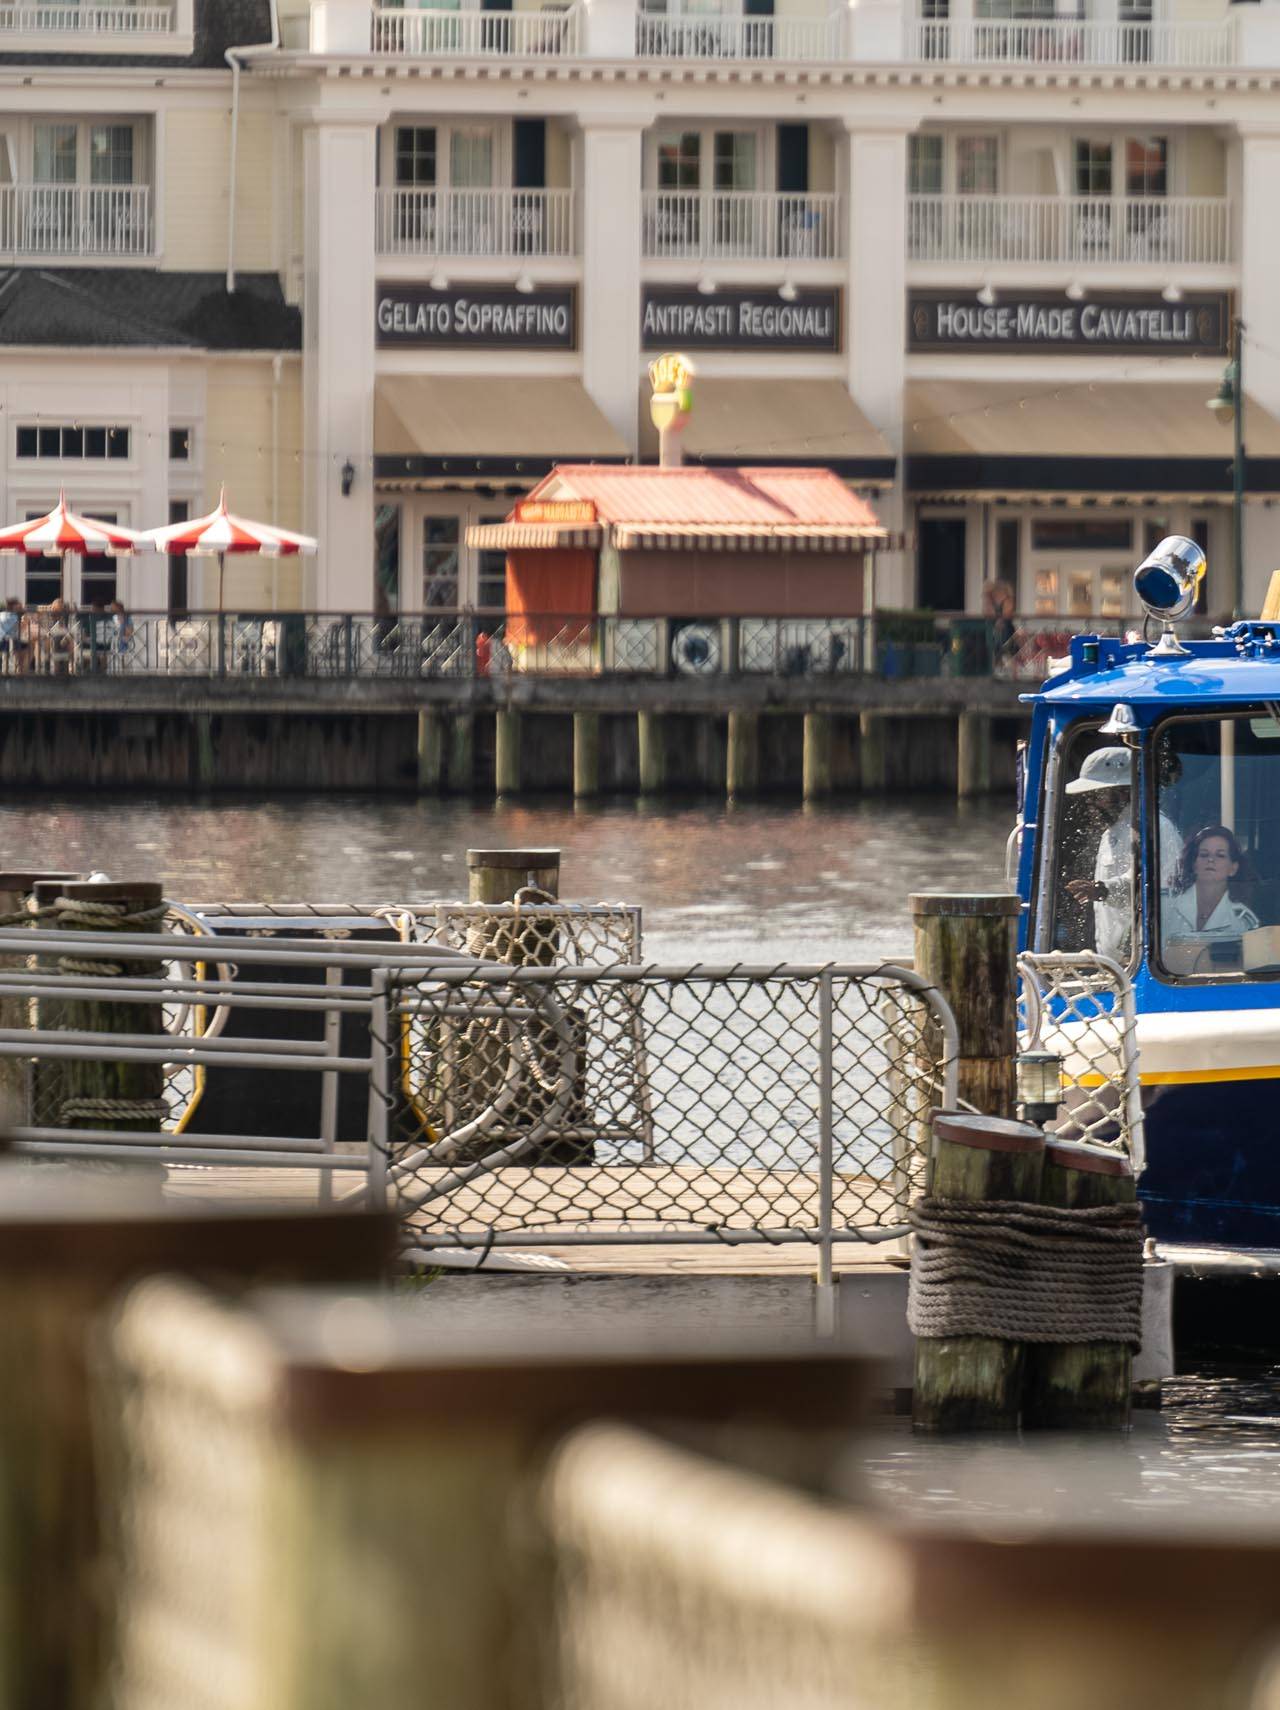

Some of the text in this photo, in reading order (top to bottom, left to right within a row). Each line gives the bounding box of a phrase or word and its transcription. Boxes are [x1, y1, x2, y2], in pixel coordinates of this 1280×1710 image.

[378, 298, 566, 334] GELATO SOPRAFFINO
[643, 301, 830, 337] ANTIPASTI REGIONALI
[936, 303, 1192, 340] HOUSE-MADE CAVATELLI
